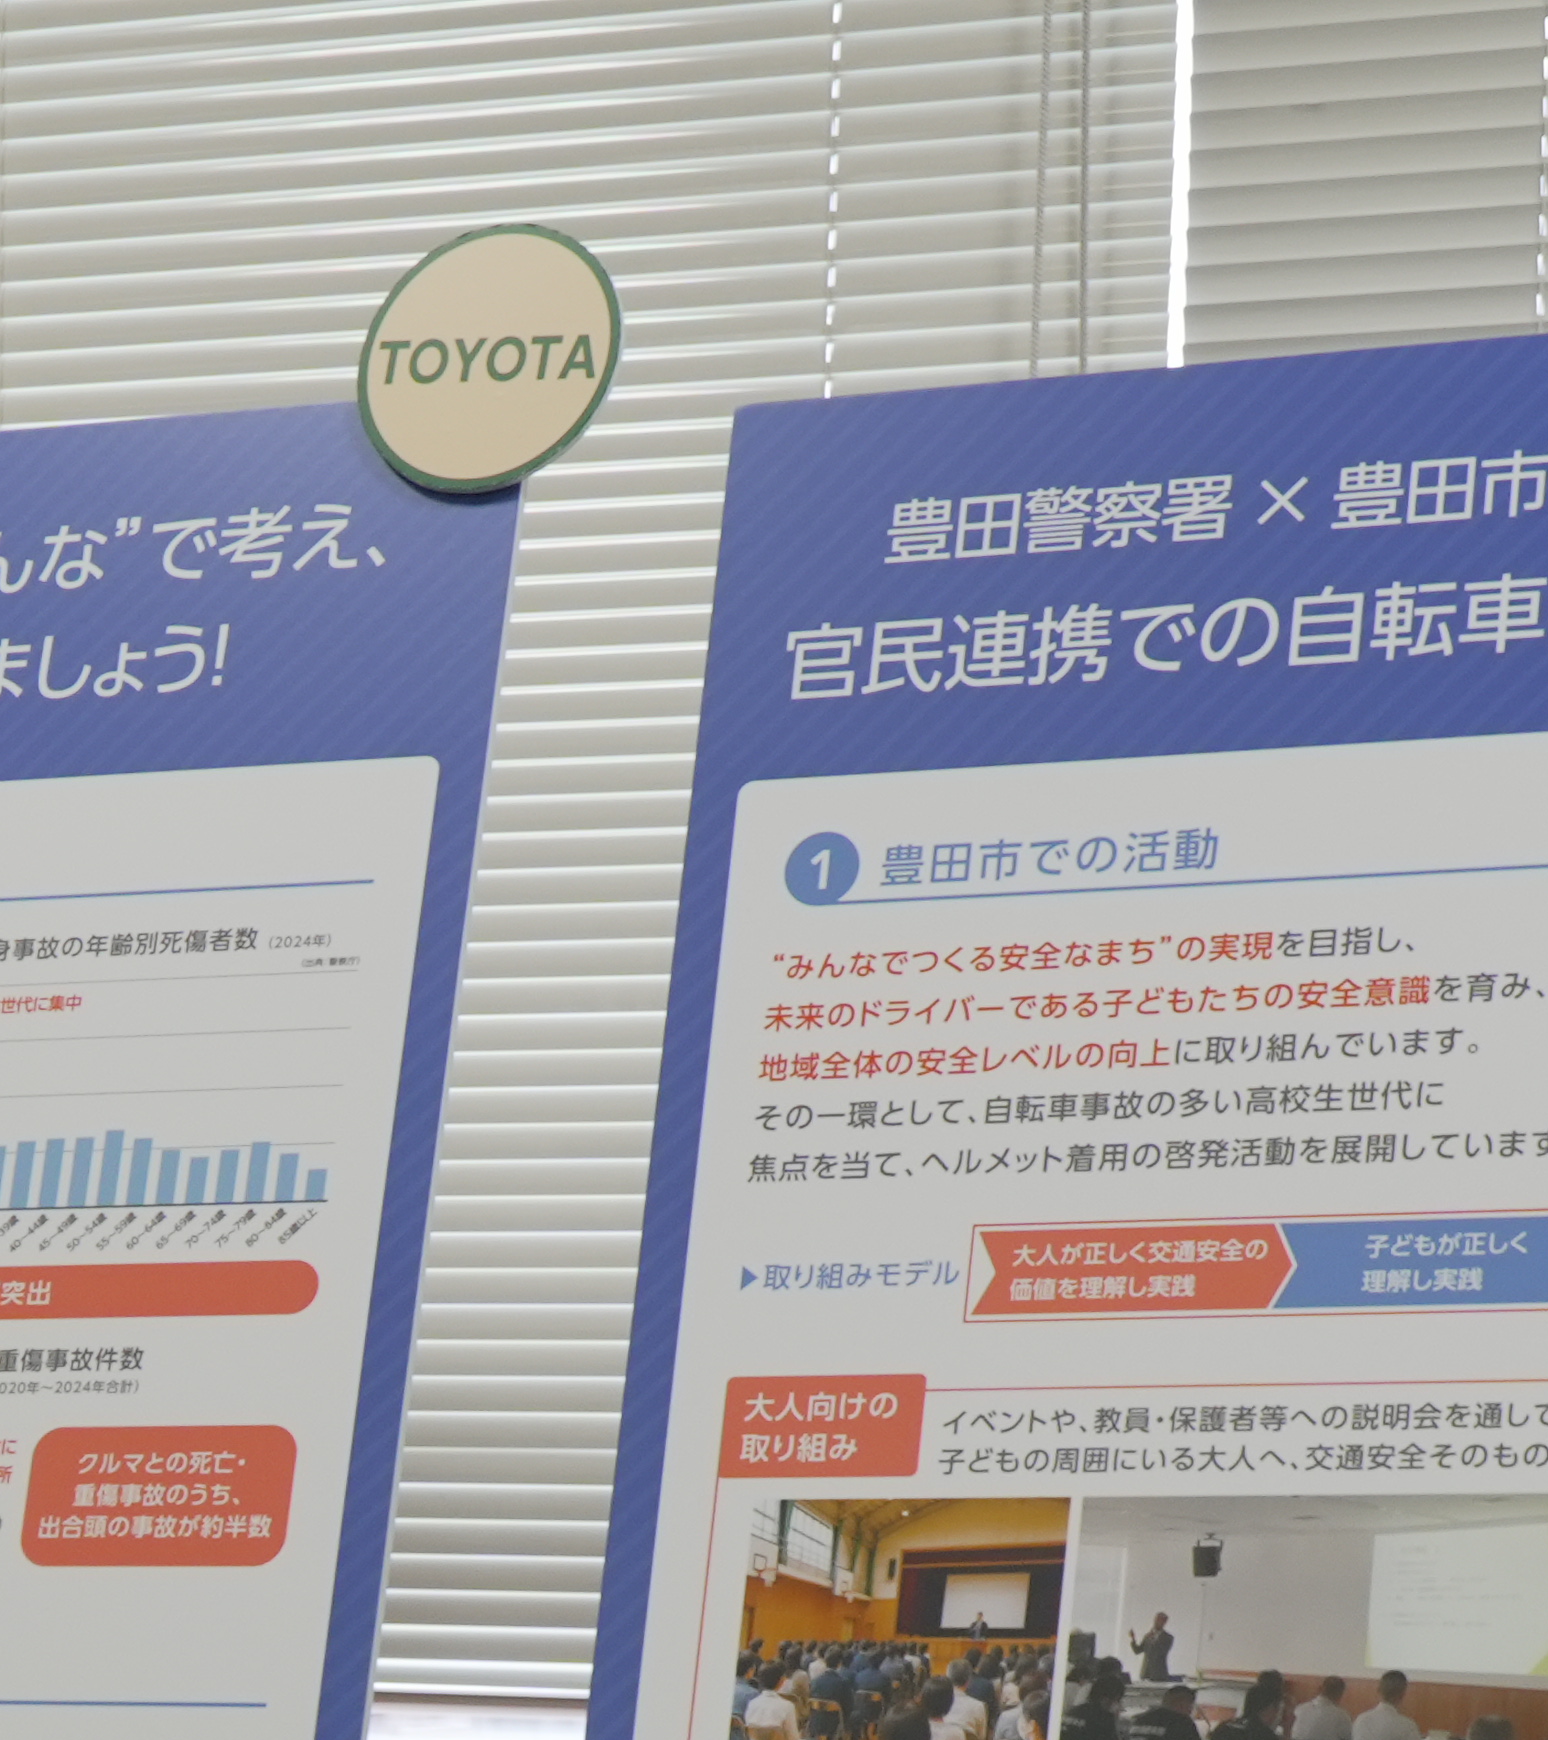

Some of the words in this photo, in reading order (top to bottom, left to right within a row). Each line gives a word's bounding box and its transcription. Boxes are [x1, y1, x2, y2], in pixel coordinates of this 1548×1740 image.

[378, 334, 599, 386] TOYOTA
[883, 473, 1232, 567] 豊田警察署
[810, 849, 834, 891] 1
[879, 827, 1220, 889] 豊田市での活動
[757, 1026, 1482, 1084] 地域全体の安全レベルの向上に取り組んでいます。
[753, 1077, 1446, 1132] その一環として、自転車事故の多い高校生世代に
[1011, 1235, 1271, 1269] 大人が正しく交通安全の
[1365, 1228, 1530, 1261] 子どもが正しく
[763, 1258, 960, 1292] 取り組みモデル
[1009, 1272, 1197, 1303] 価値を理解し実践
[1361, 1265, 1483, 1295] 理解し実践
[743, 1391, 898, 1423] 大人向けの
[739, 1433, 858, 1463] 取り組み
[72, 1483, 241, 1508] 重傷事故のうち、
[37, 1514, 272, 1540] 出合頭の事故が約半数
